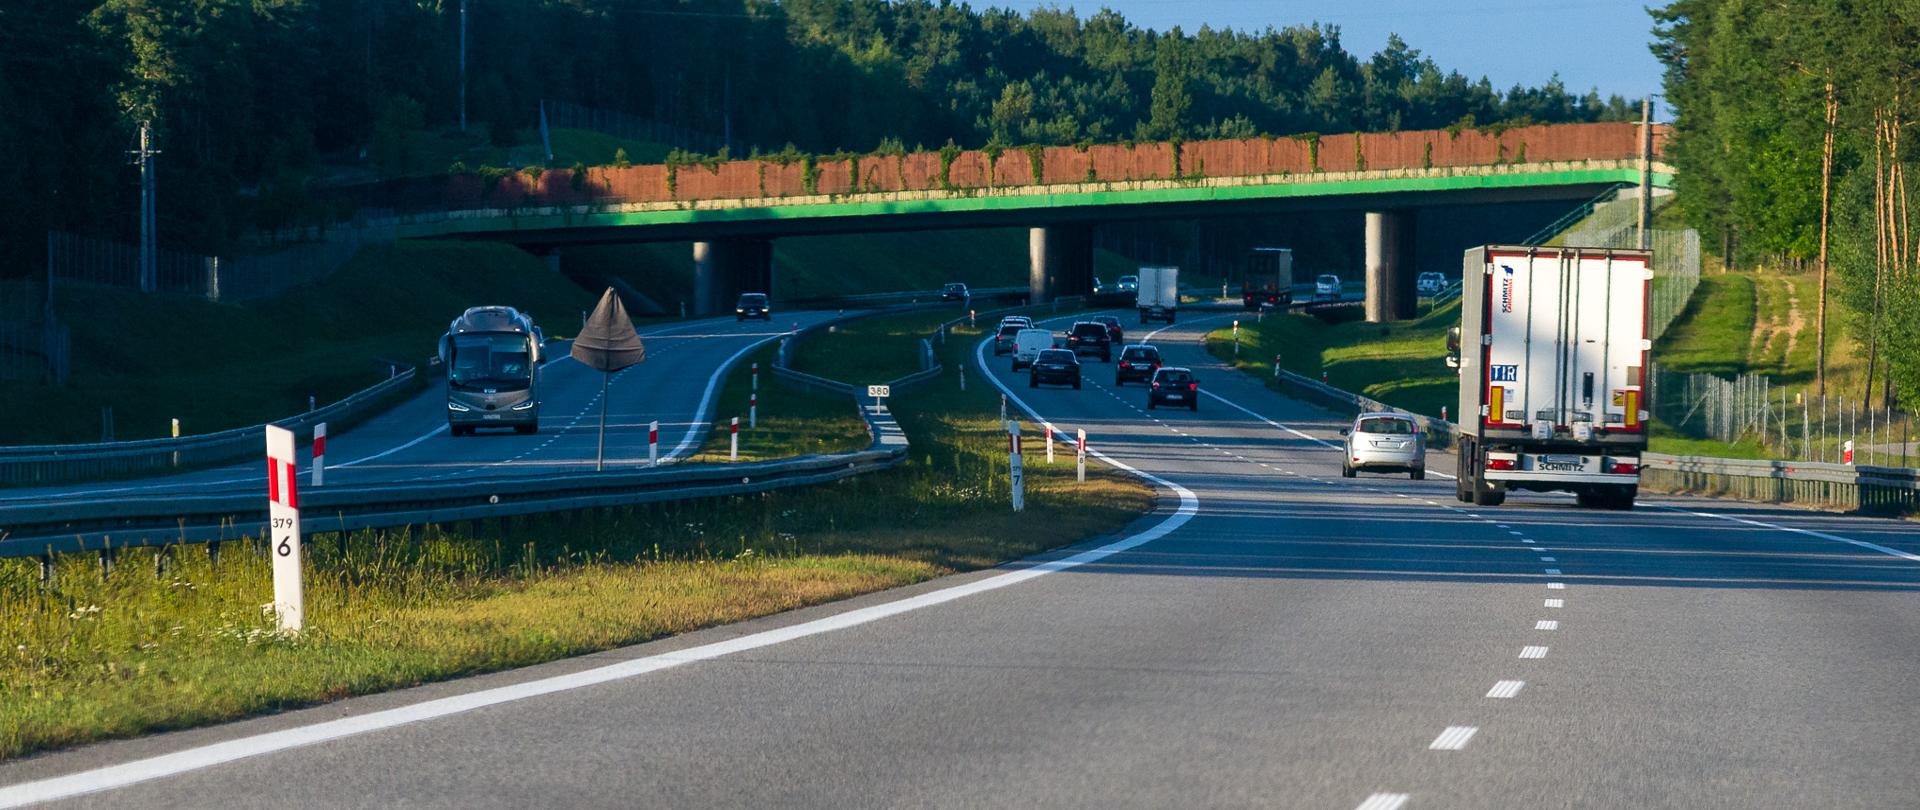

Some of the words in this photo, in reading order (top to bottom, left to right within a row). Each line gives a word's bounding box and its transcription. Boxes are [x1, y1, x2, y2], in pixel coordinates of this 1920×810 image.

[1492, 365, 1515, 380] TIR
[870, 386, 889, 396] 380
[1539, 463, 1584, 471] SCHMITZ
[1013, 475, 1020, 486] 7
[272, 518, 293, 529] 379
[277, 535, 291, 557] 6
